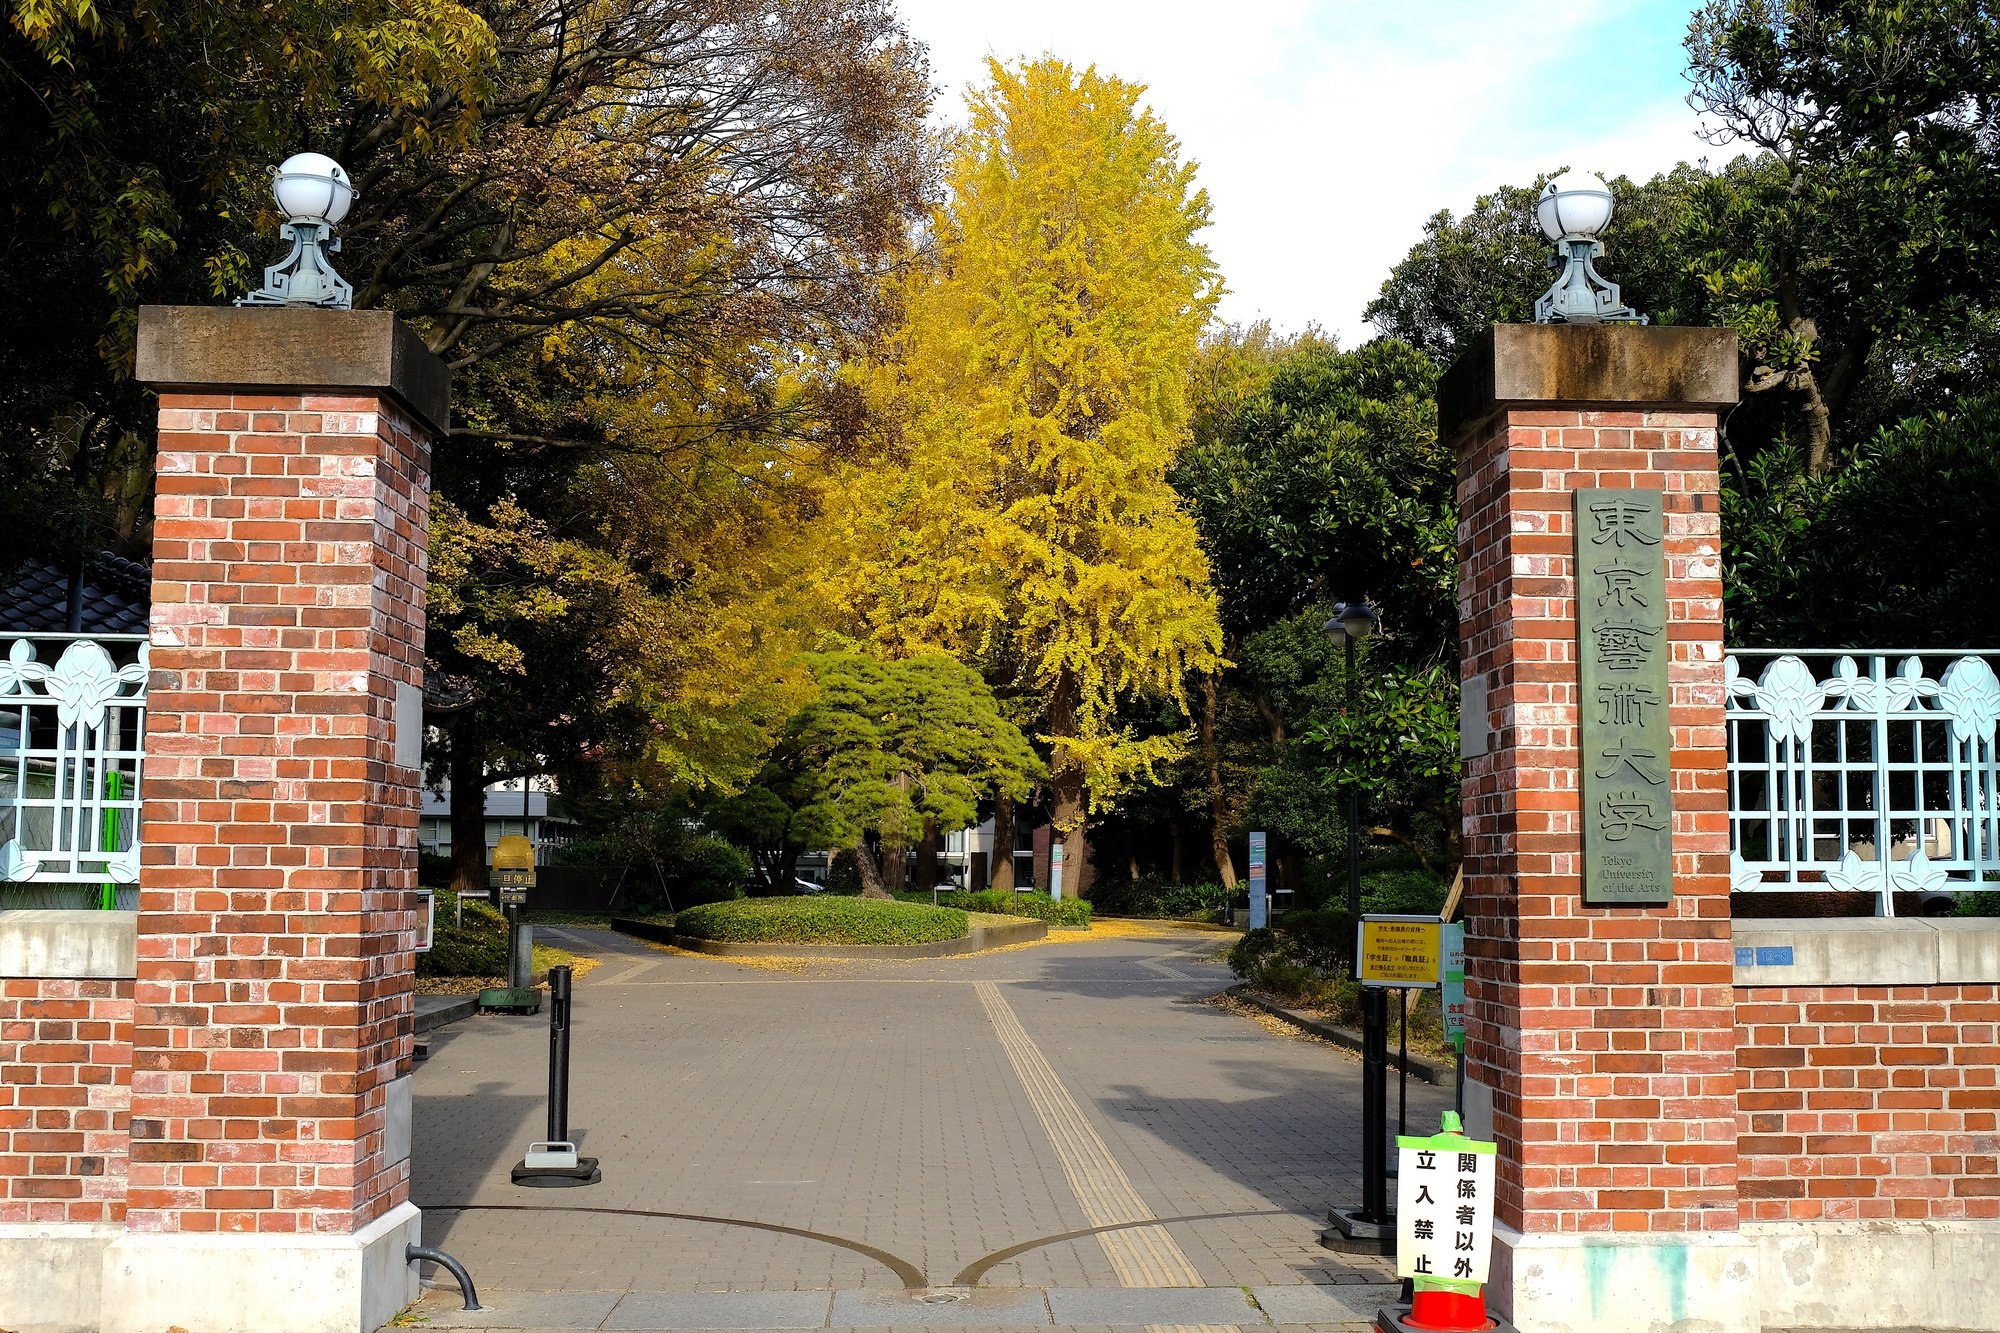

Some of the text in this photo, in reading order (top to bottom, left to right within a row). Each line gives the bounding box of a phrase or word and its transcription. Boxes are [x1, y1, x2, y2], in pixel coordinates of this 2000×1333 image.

[1590, 498, 1668, 841] 東京藝術大学
[1602, 856, 1632, 868] Tokyo
[491, 874, 534, 885] 一旦停止
[1602, 869, 1655, 881] University
[1602, 882, 1660, 892] of the Arts
[1761, 950, 1789, 961] 12-8
[1414, 1150, 1436, 1275] 立入禁止
[1454, 1153, 1477, 1278] 関係者以外
